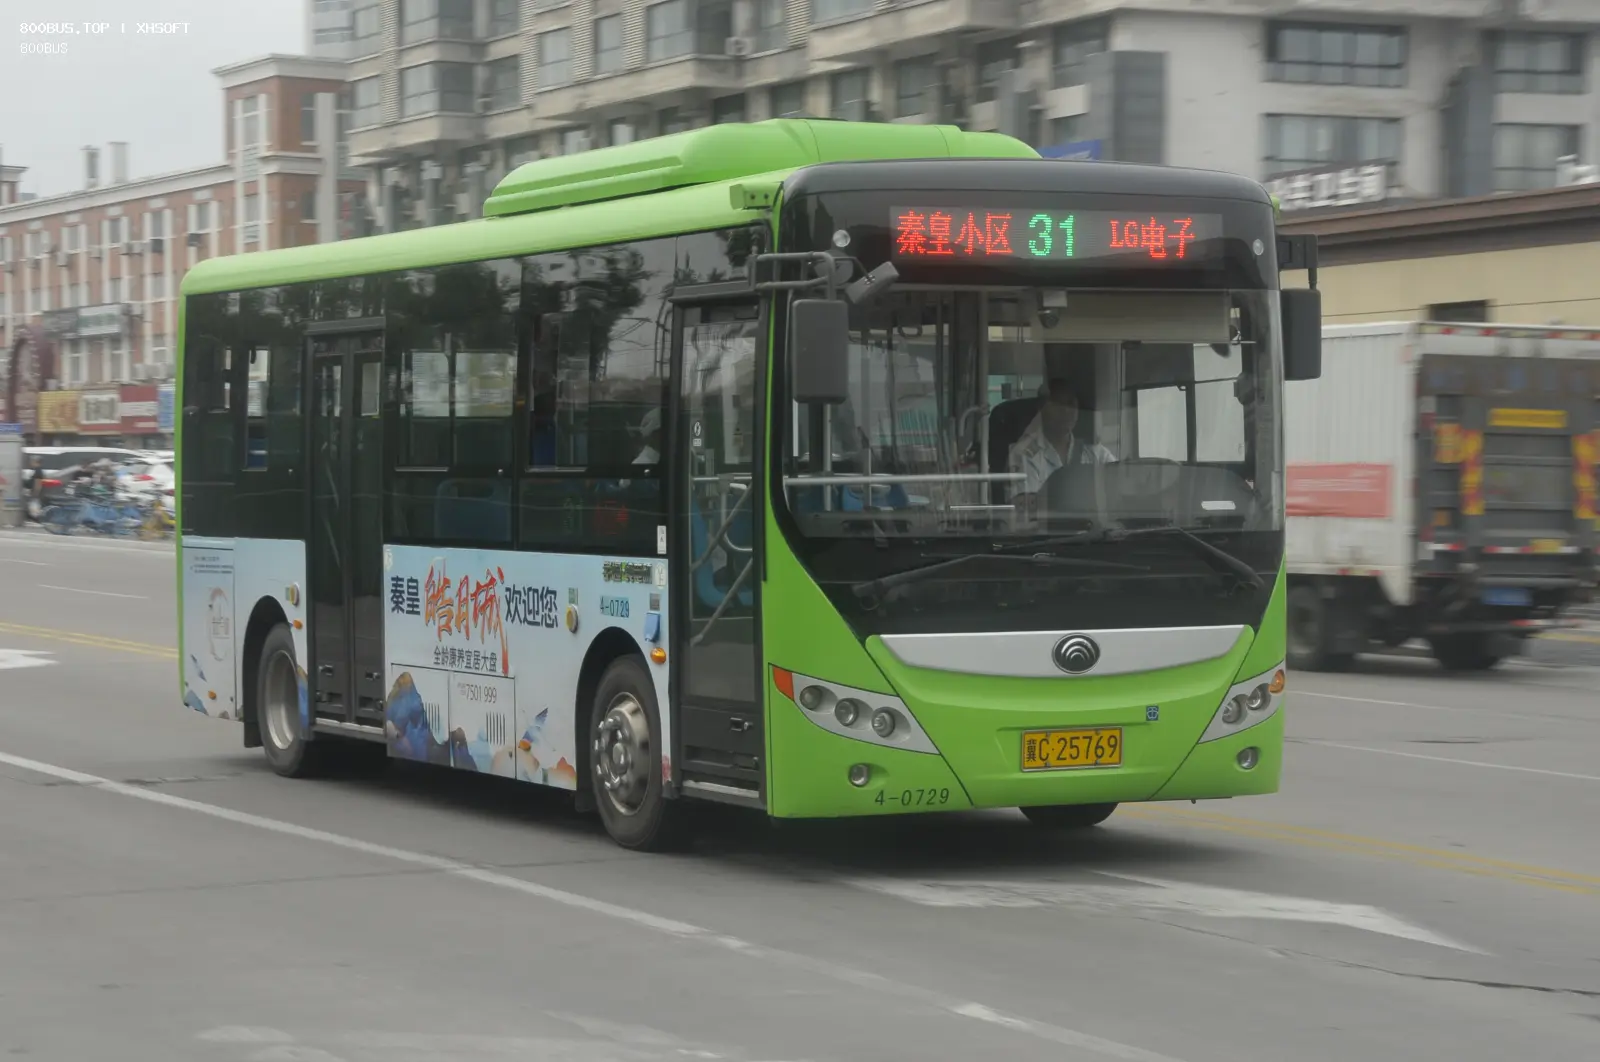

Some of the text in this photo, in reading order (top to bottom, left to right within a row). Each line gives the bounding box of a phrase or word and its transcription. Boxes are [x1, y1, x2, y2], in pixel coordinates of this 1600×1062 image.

[896, 210, 1196, 259] 秦皇小区 31 LG电子
[600, 595, 630, 618] 4-0729
[874, 788, 950, 806] 4-0729
